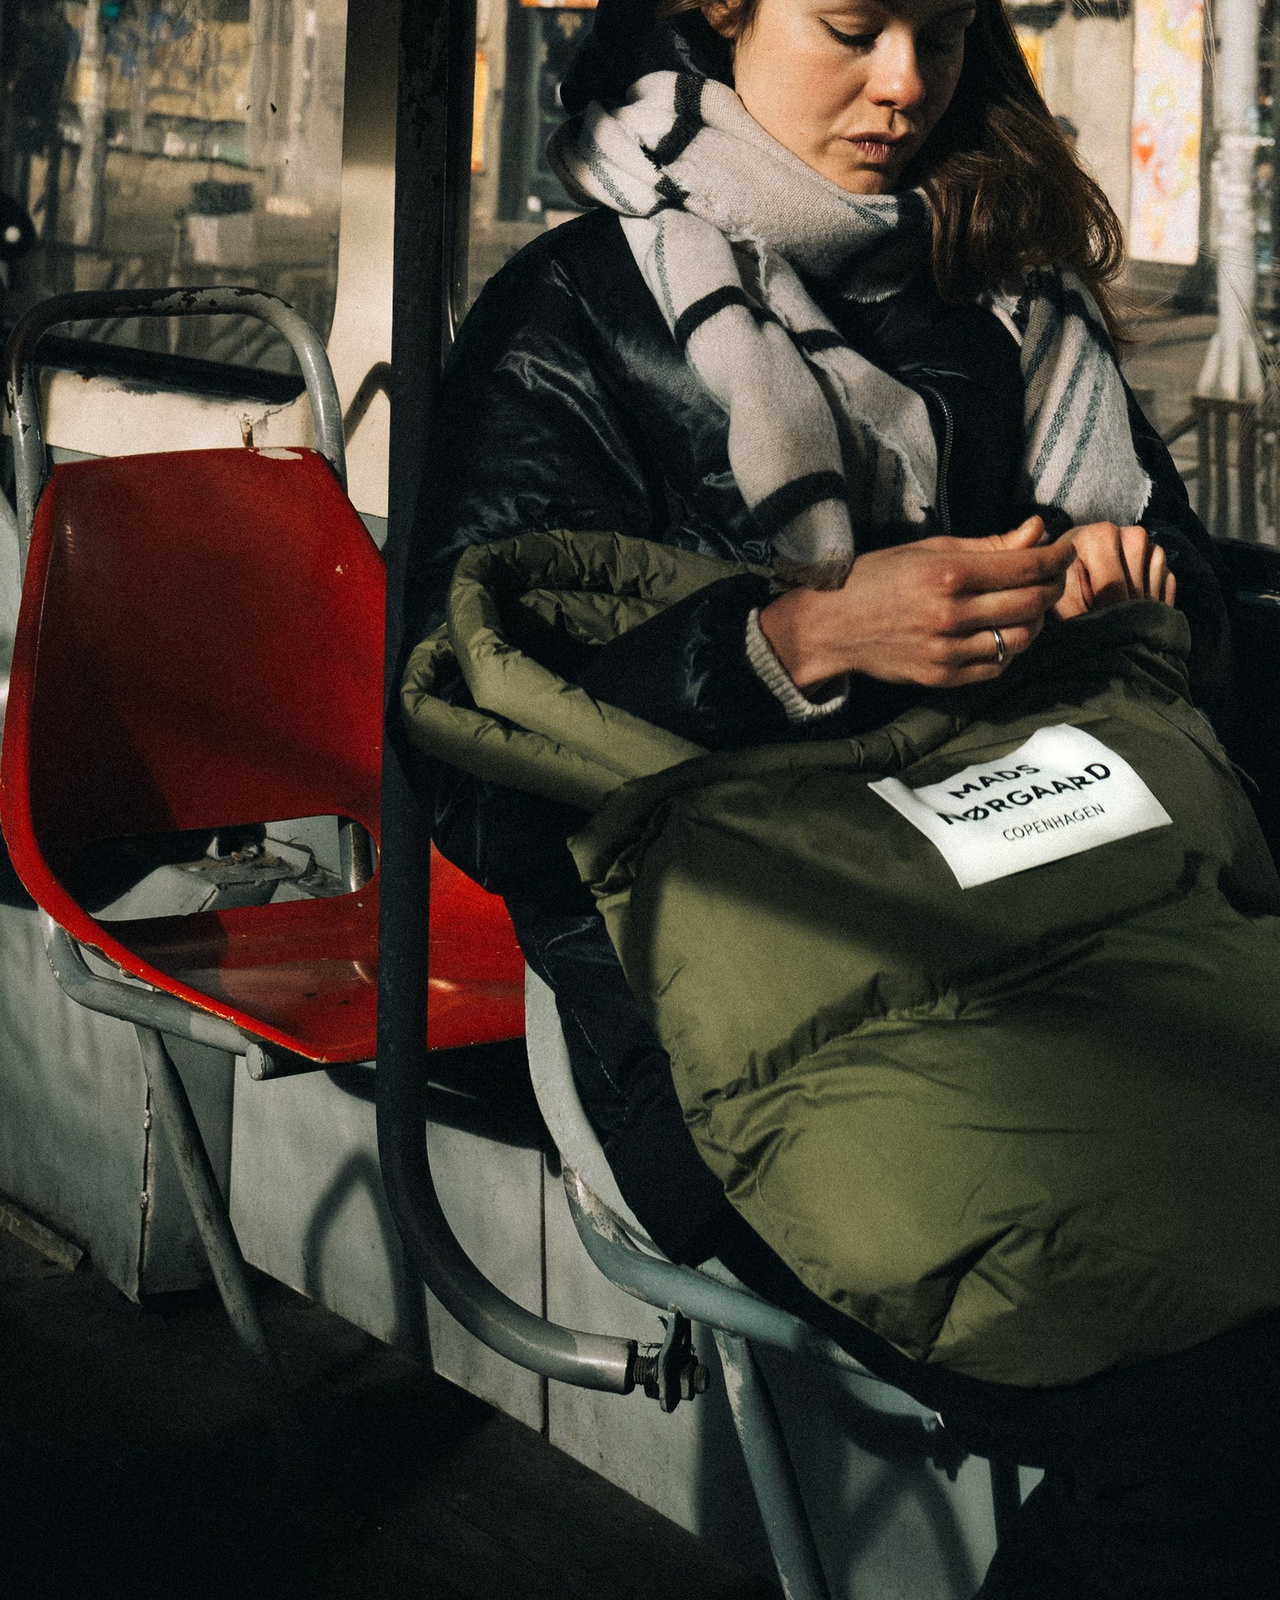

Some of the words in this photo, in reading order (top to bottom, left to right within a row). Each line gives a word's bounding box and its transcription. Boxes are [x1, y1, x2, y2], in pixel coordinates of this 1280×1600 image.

[936, 762, 1111, 825] NØRGAARD
[947, 764, 1041, 799] MADS
[1002, 802, 1106, 842] COPENHAGEN
